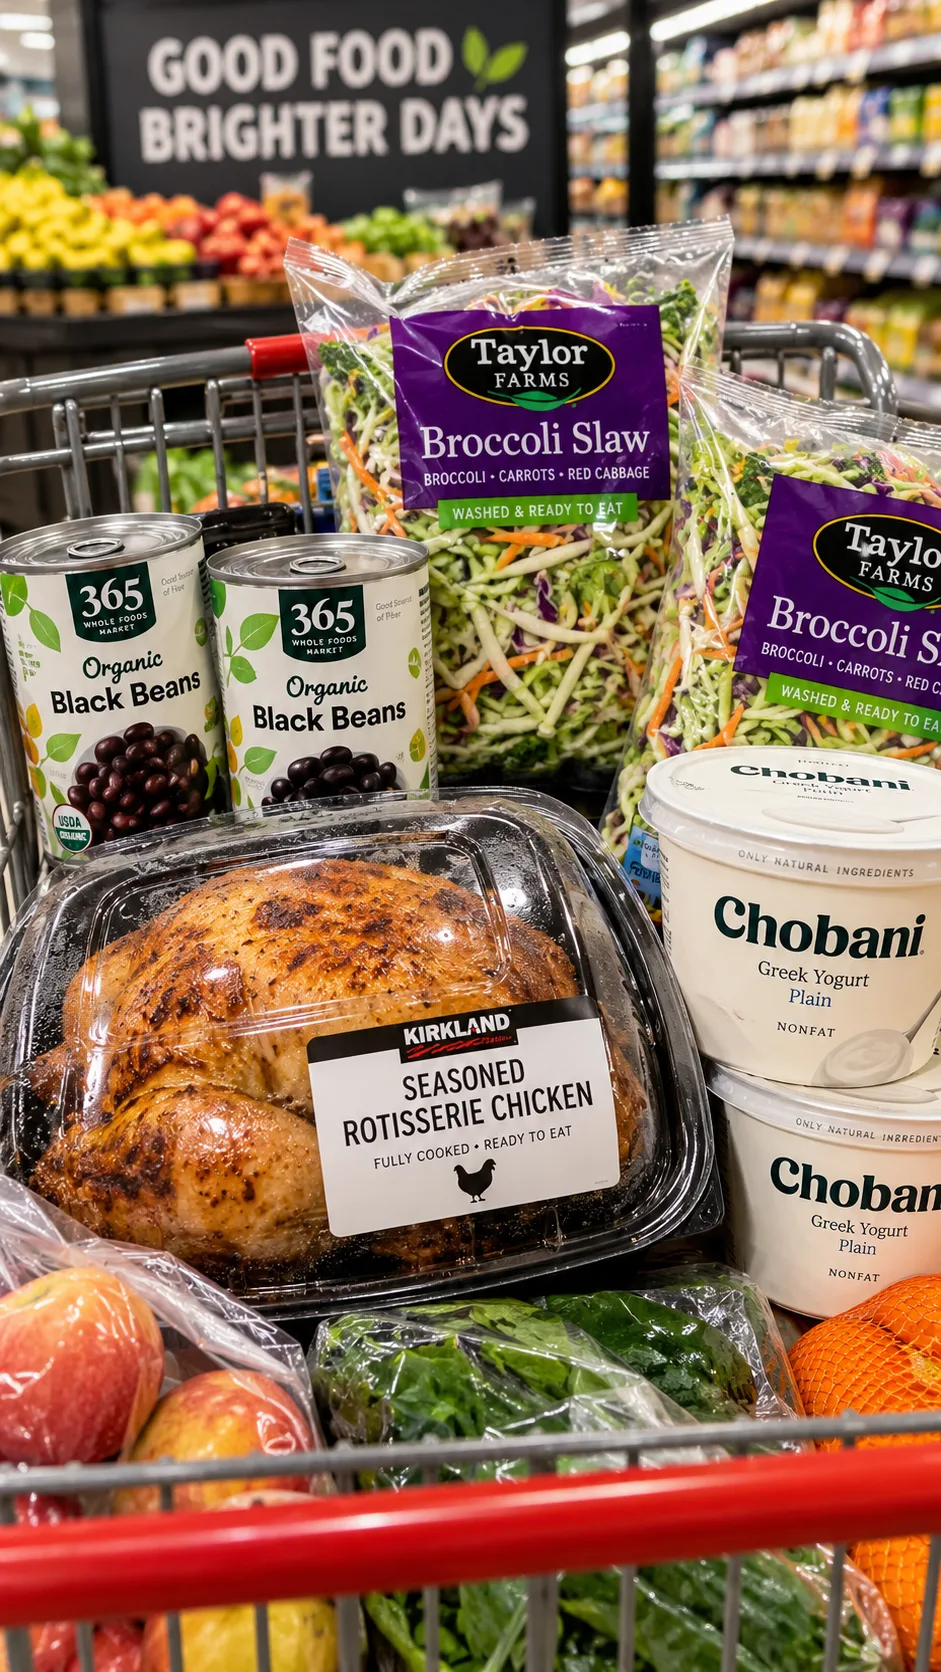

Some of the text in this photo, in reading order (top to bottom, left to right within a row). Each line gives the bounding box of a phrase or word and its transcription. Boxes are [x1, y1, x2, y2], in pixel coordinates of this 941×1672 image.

[148, 27, 453, 96] GOOD FOOD
[140, 94, 530, 164] BRIGHTER DAYS
[471, 338, 588, 371] Taylor
[495, 372, 570, 388] FARMS
[420, 420, 650, 459] Broccoli Slaw
[424, 466, 650, 487] BROCCOLI CARROTS RED CABBAGE
[453, 502, 624, 520] WASHED & READY TO EAT
[858, 560, 934, 592] FARMS
[80, 577, 143, 617] 365
[83, 612, 148, 628] WHOLE FOODS
[290, 597, 356, 636] 365
[767, 595, 941, 666] Broccoli S
[292, 635, 357, 647] WHOLE FOODS
[306, 646, 343, 655] MARKET
[82, 650, 164, 683] Organic
[761, 642, 941, 695] BROCCOLI CARROTS RED C
[50, 670, 202, 714] Black Beans
[286, 675, 368, 705] Organic
[253, 701, 406, 732] Black Beans
[781, 685, 838, 708] WASHED
[841, 699, 851, 712] &
[855, 701, 900, 722] READY
[903, 713, 920, 727] TO
[730, 765, 912, 791] Chobani
[58, 815, 82, 828] USDA
[738, 850, 915, 878] ONLY NATURAL INGREDIENTS
[714, 895, 926, 960] Chobani
[757, 960, 870, 991] Greek Yogurt
[788, 988, 832, 1008] Plain
[403, 1013, 510, 1046] KIRKLAND
[777, 1021, 836, 1038] NONFAT
[402, 1058, 525, 1101] SEASONED
[343, 1081, 594, 1147] ROTISSERIE CHICKEN
[796, 1118, 823, 1131] ONLY
[828, 1125, 875, 1140] NATURAL
[373, 1125, 573, 1169] FULLY COOKED READY TO EAT
[811, 1214, 909, 1239] Greek Yogurt
[838, 1239, 877, 1256] Plain
[828, 1268, 881, 1283] NONFAT
